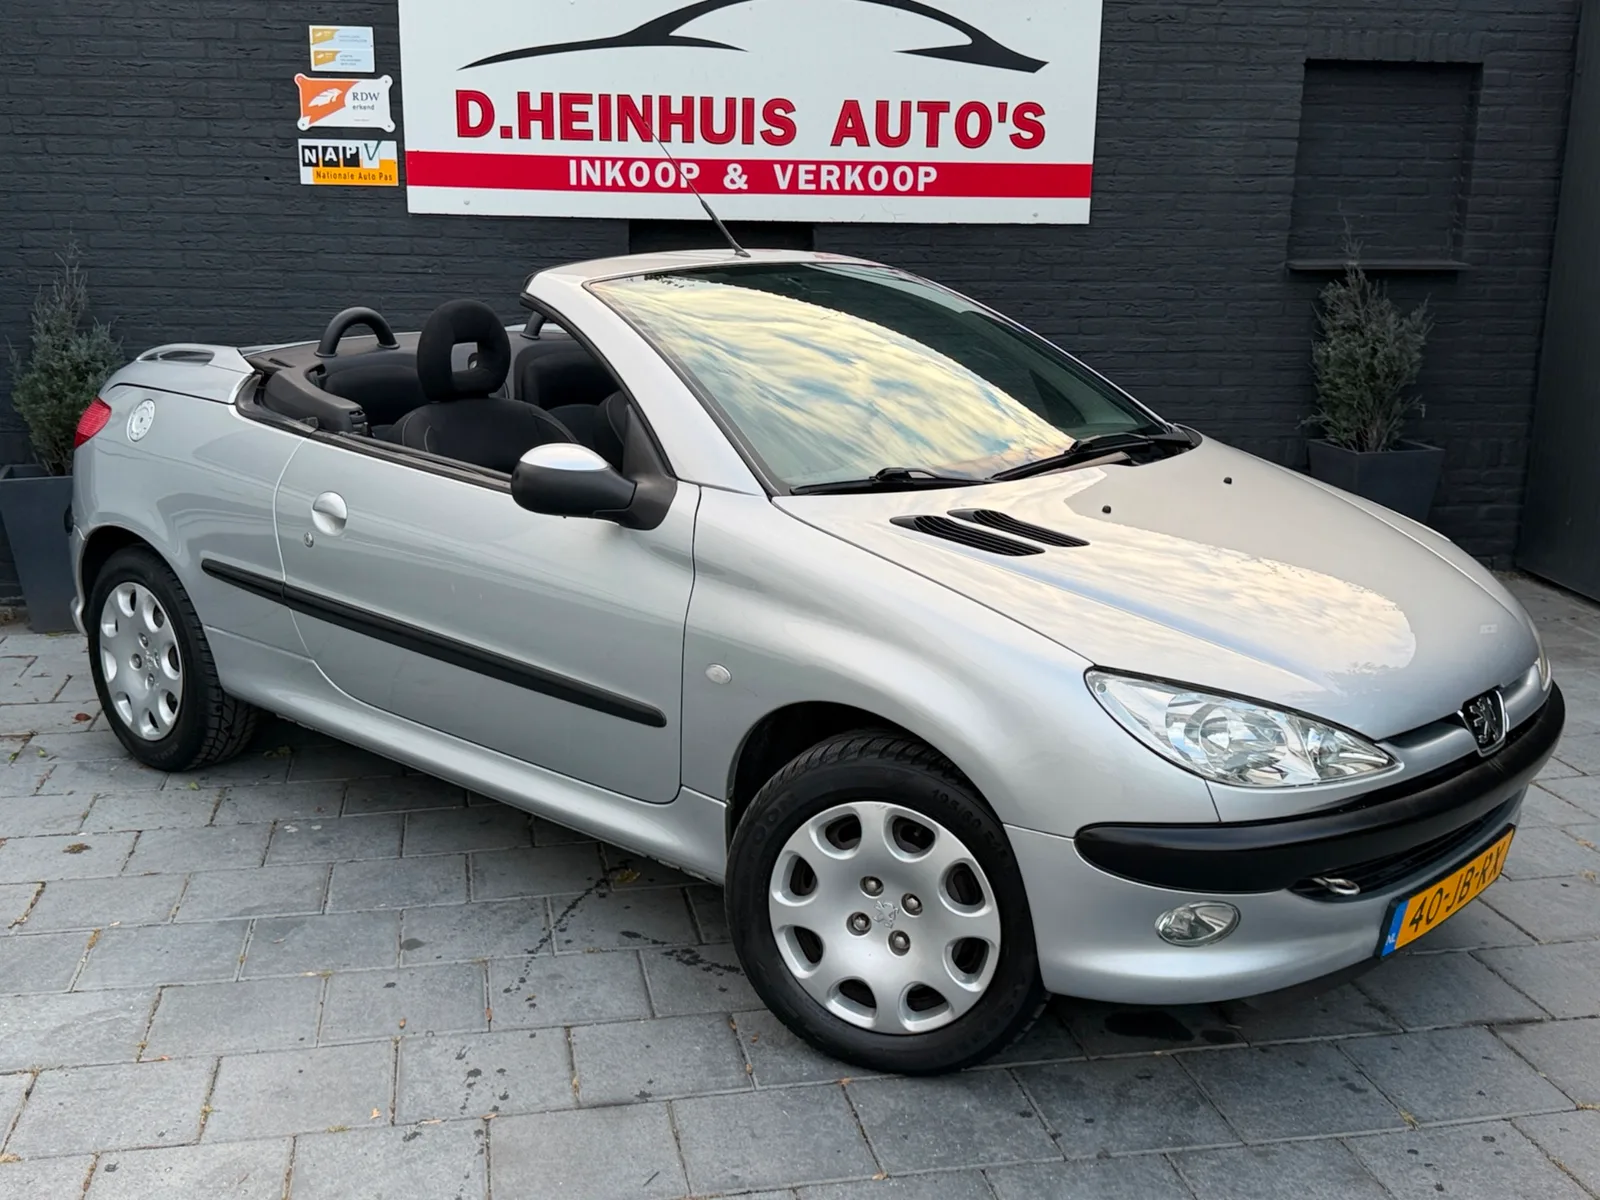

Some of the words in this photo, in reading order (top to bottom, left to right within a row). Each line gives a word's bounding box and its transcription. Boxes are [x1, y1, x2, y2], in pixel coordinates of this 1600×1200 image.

[352, 91, 380, 102] RDW
[456, 90, 796, 145] D.HEINHUIS
[832, 100, 1046, 149] AUTO'S
[316, 170, 354, 180] Nationale
[357, 172, 376, 181] Auto
[379, 172, 393, 181] Pas
[569, 159, 700, 190] INKOOP
[723, 163, 748, 191] &
[773, 164, 938, 193] VERKOOP
[1408, 841, 1506, 933] 40-JB-RX
[1385, 933, 1396, 946] NL
